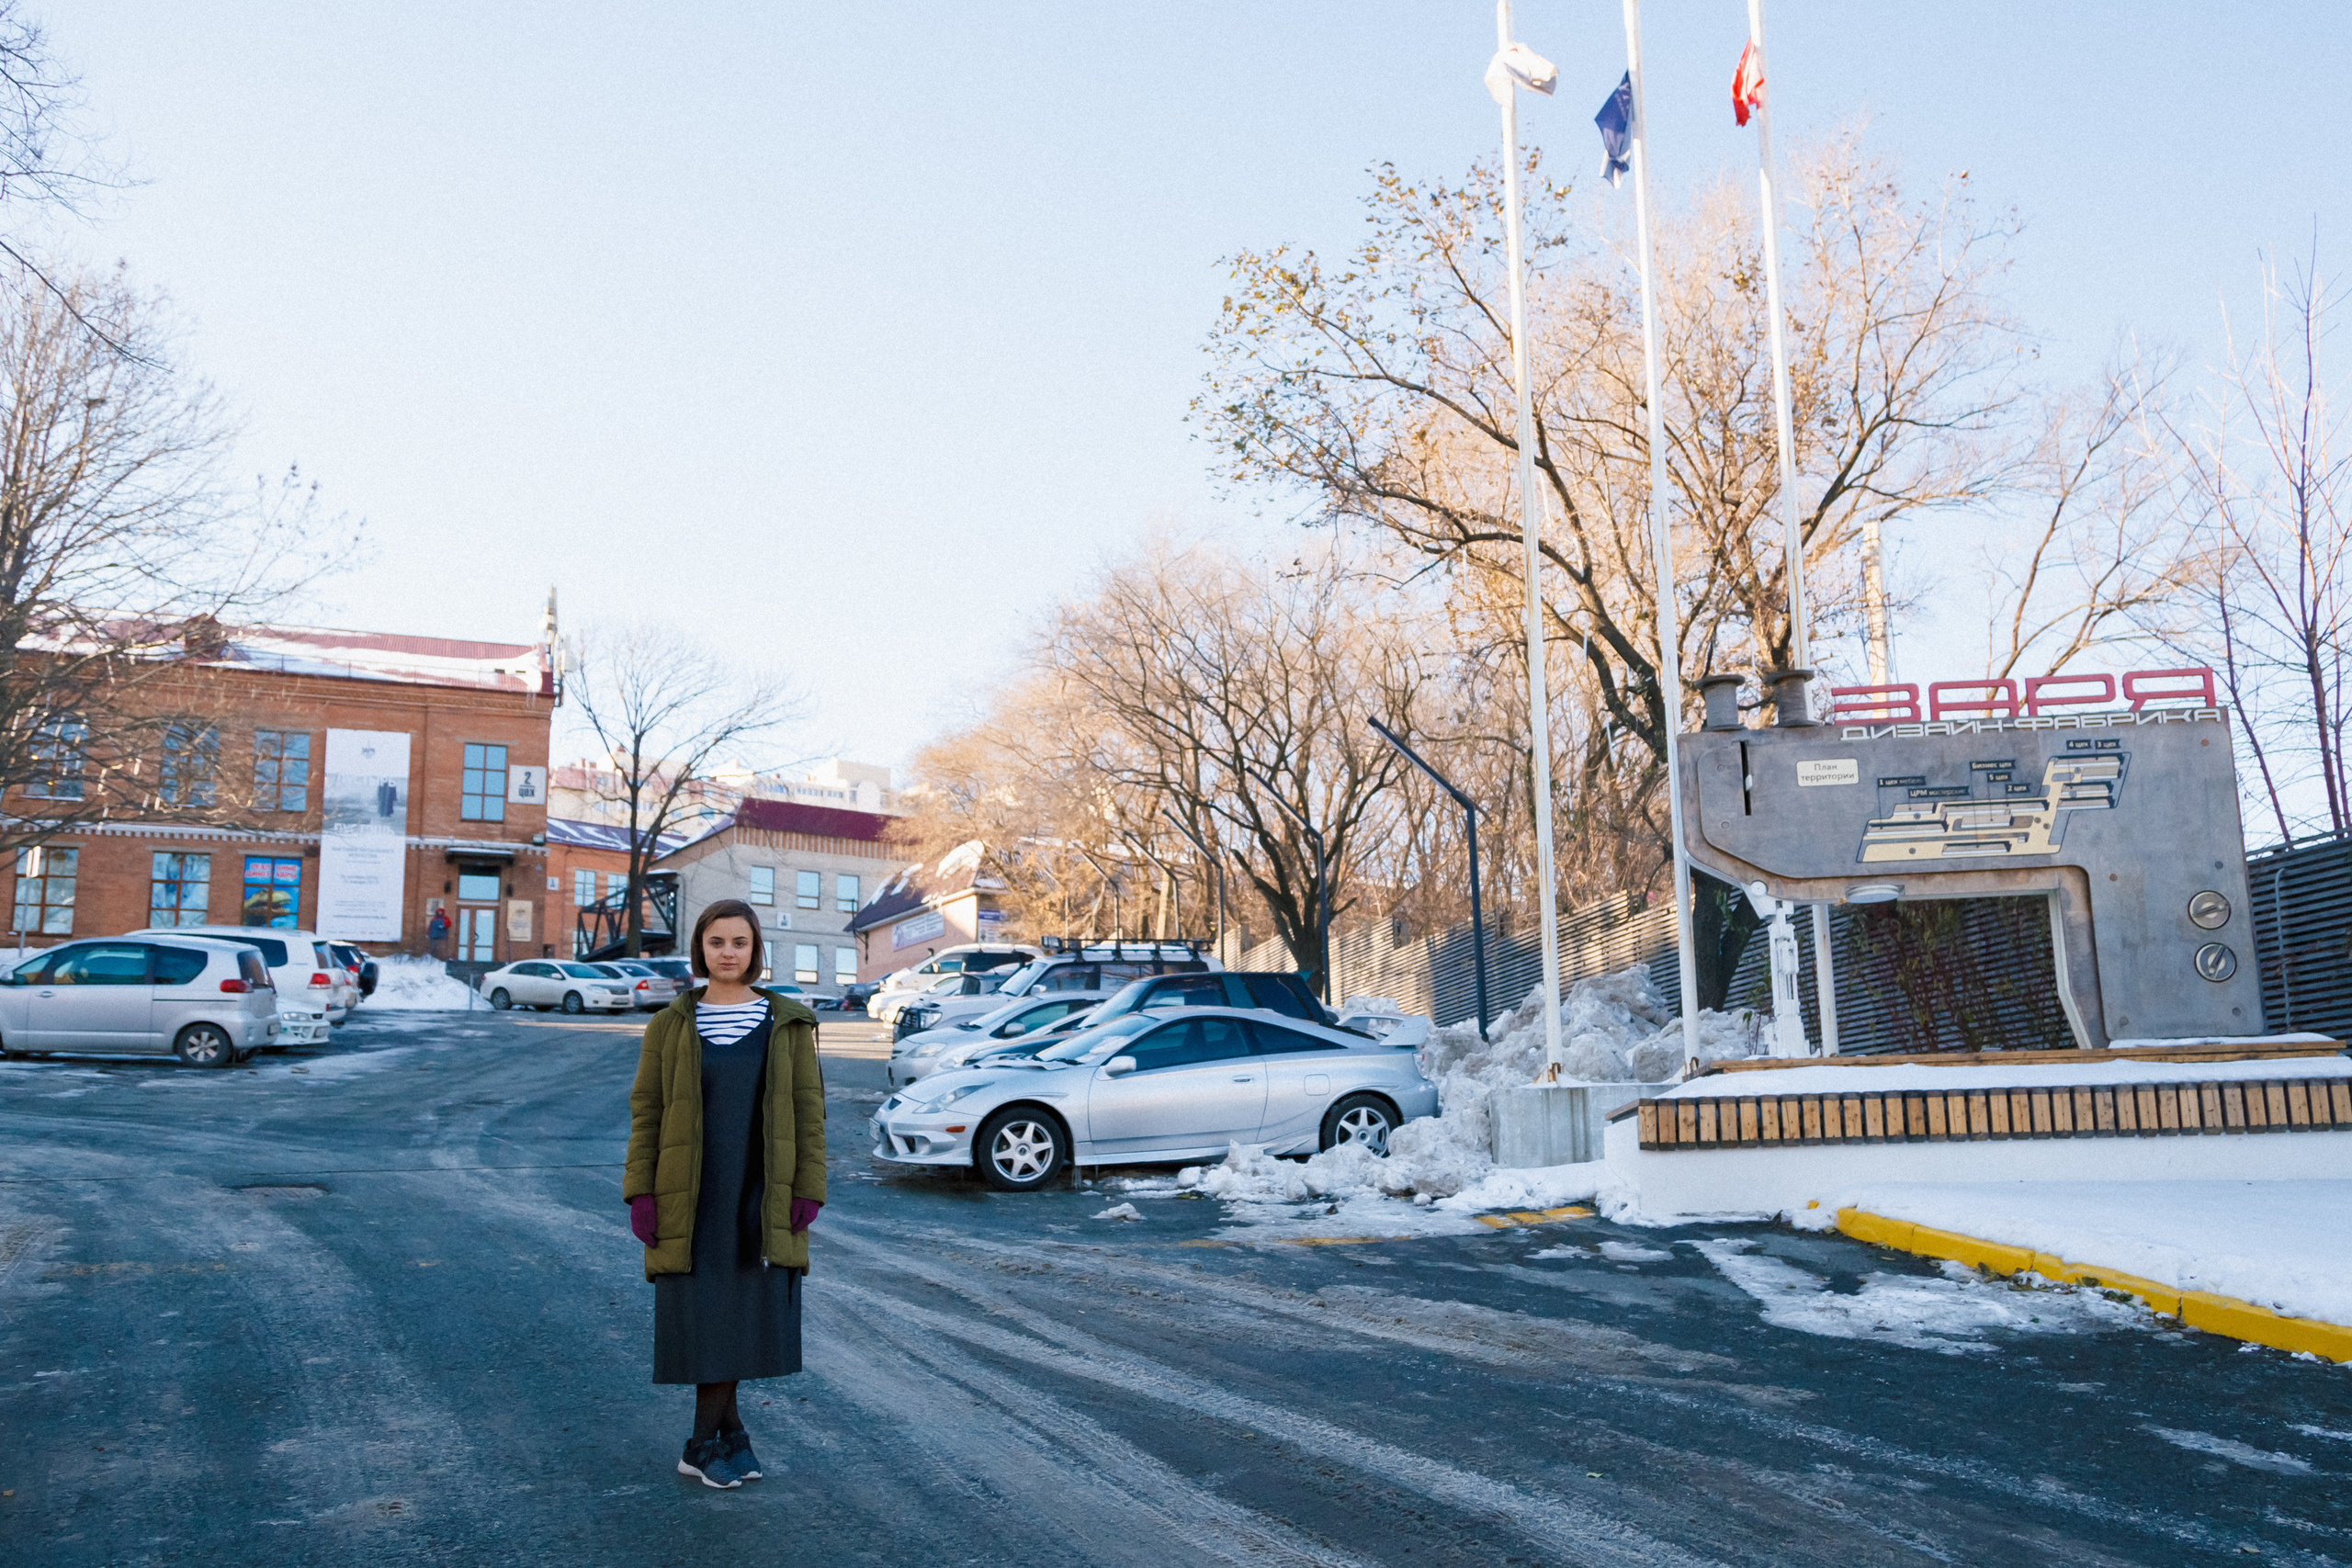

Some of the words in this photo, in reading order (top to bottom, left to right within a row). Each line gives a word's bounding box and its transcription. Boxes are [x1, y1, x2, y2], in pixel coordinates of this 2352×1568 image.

[1831, 667, 2217, 725] ЗАРЯ
[1840, 708, 2222, 740] ДИЗАЙН-ФАБРИКА
[524, 771, 532, 784] 2
[1801, 773, 1855, 783] территории
[1909, 789, 1928, 797] ЦРМ
